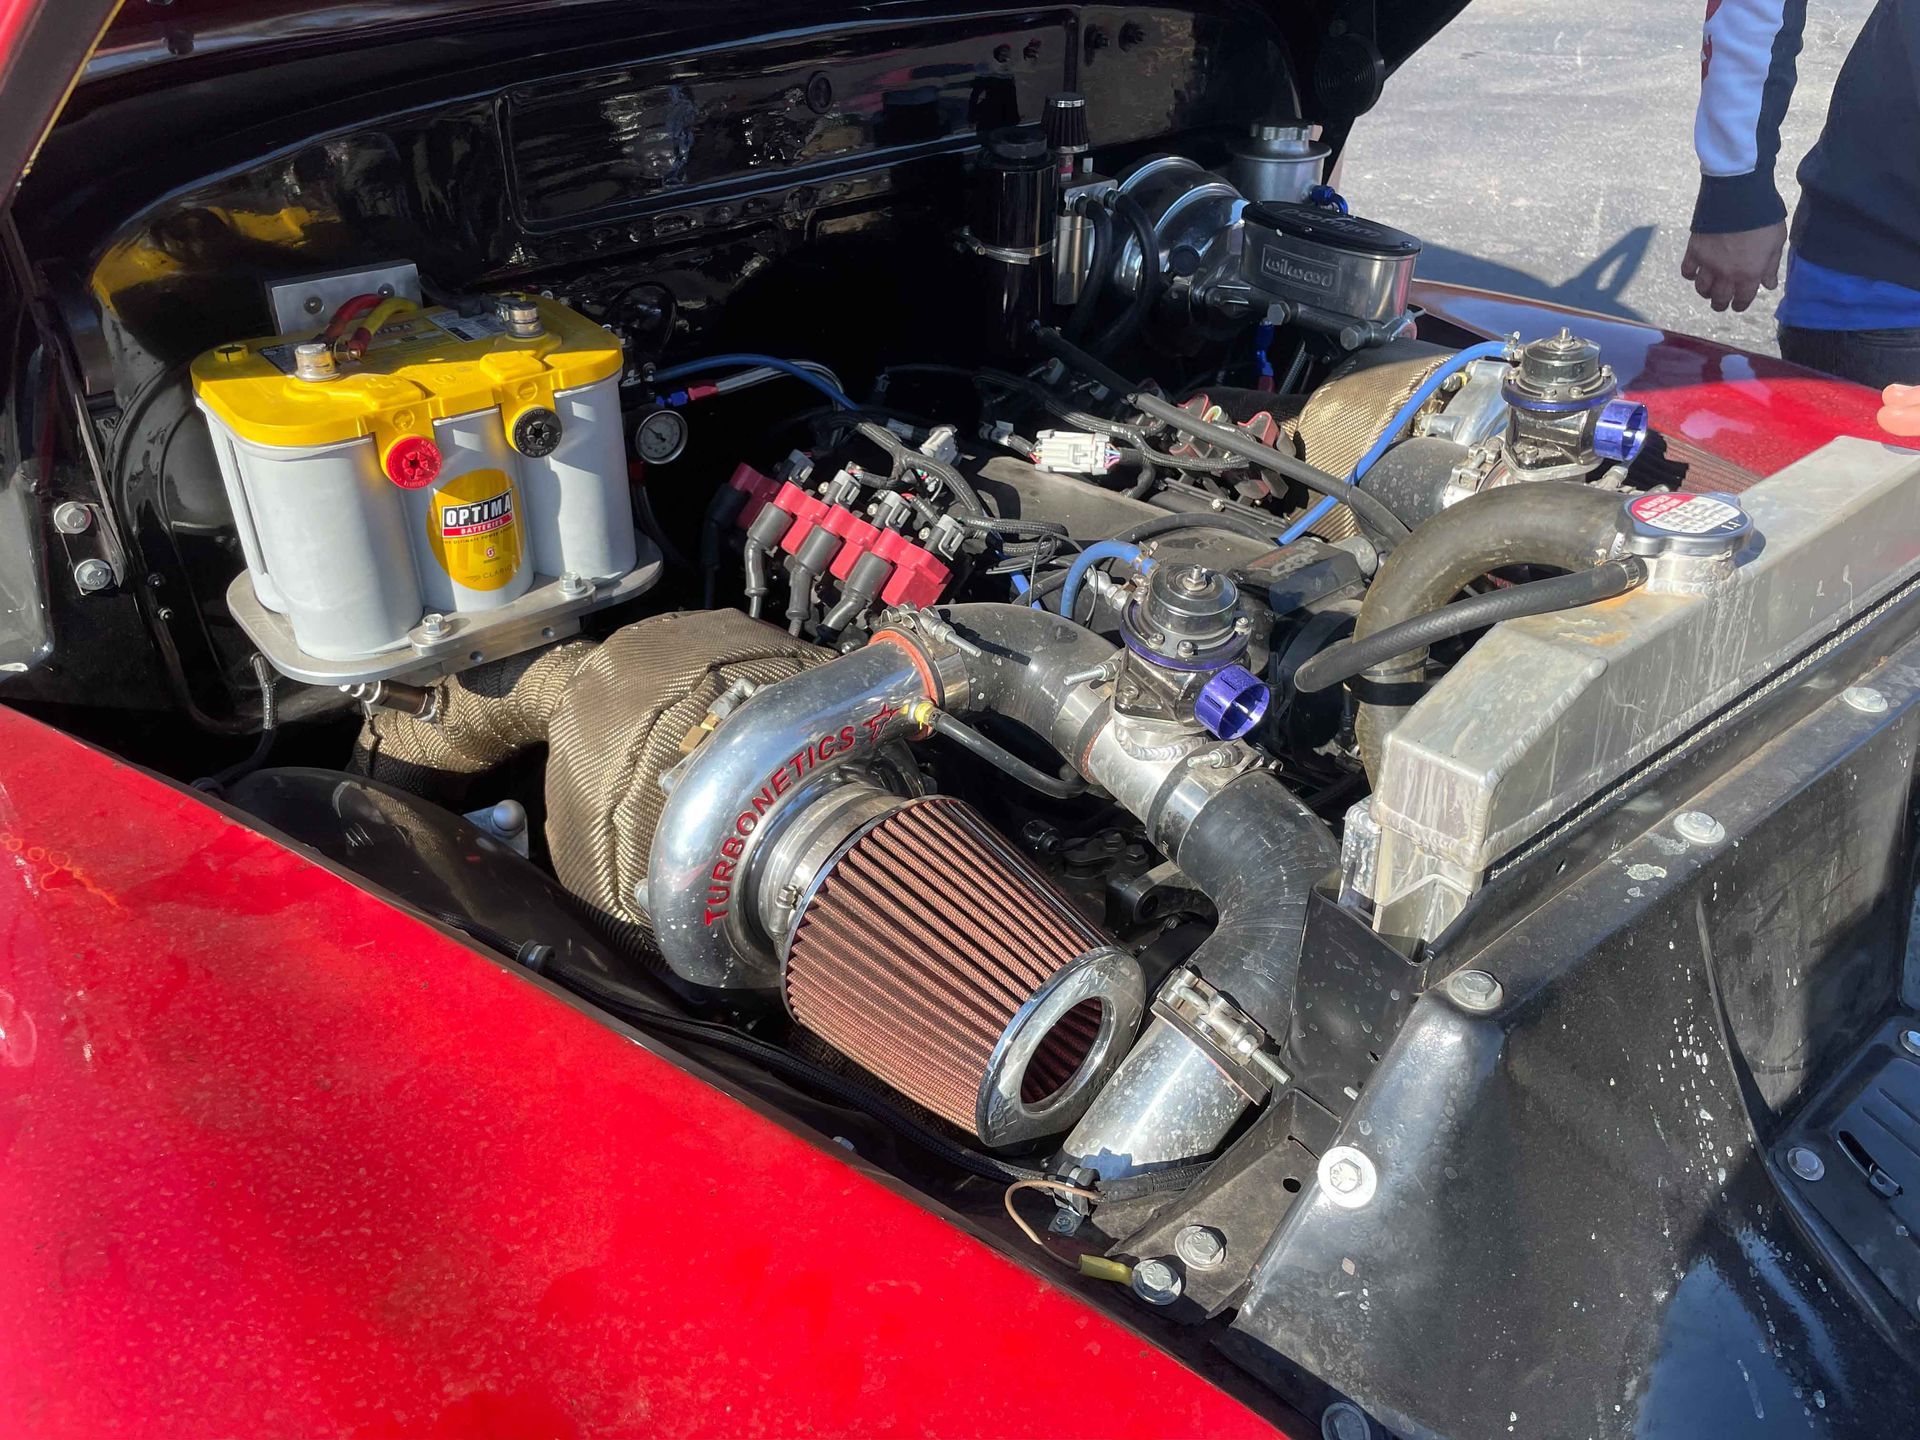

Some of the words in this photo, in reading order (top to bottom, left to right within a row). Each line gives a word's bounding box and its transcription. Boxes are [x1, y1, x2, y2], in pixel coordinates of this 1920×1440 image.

[1265, 256, 1334, 288] wilwood
[445, 493, 512, 527] OPTIMA
[461, 519, 503, 535] BATTERIES
[704, 725, 857, 927] TURBONETICS
